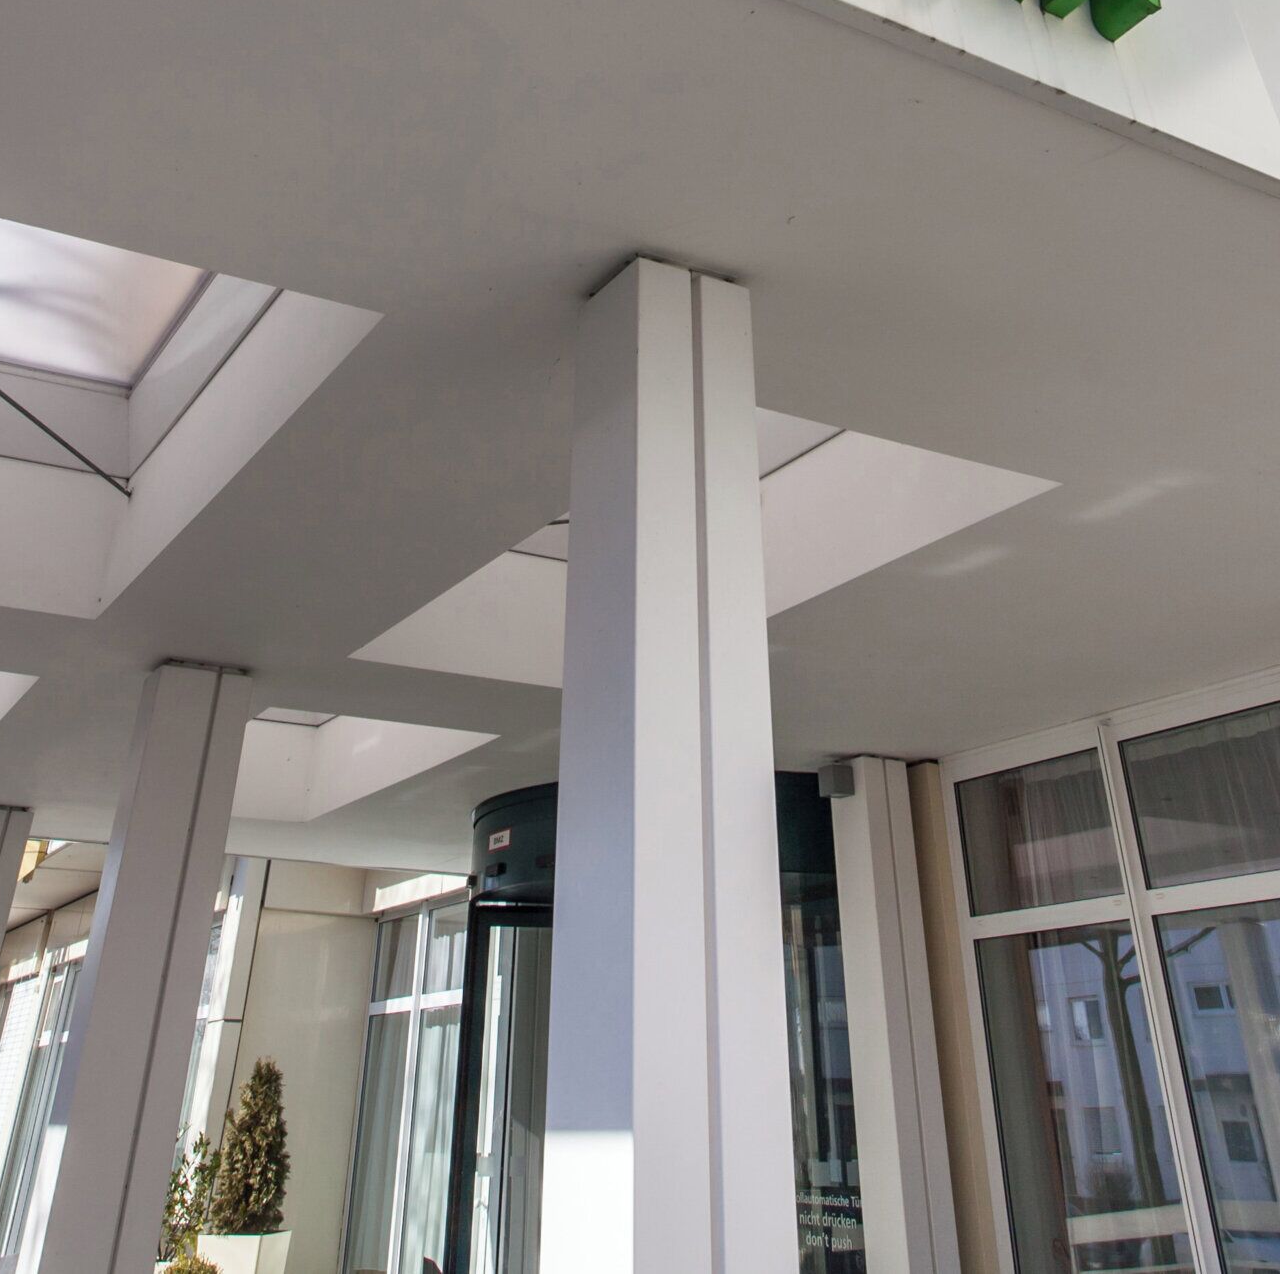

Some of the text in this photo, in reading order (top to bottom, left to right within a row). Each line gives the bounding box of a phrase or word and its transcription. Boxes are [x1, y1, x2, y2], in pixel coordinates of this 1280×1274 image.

[796, 1191, 849, 1207] ollautomatische
[799, 1210, 857, 1229] nicht drücken
[806, 1230, 853, 1252] don't push
